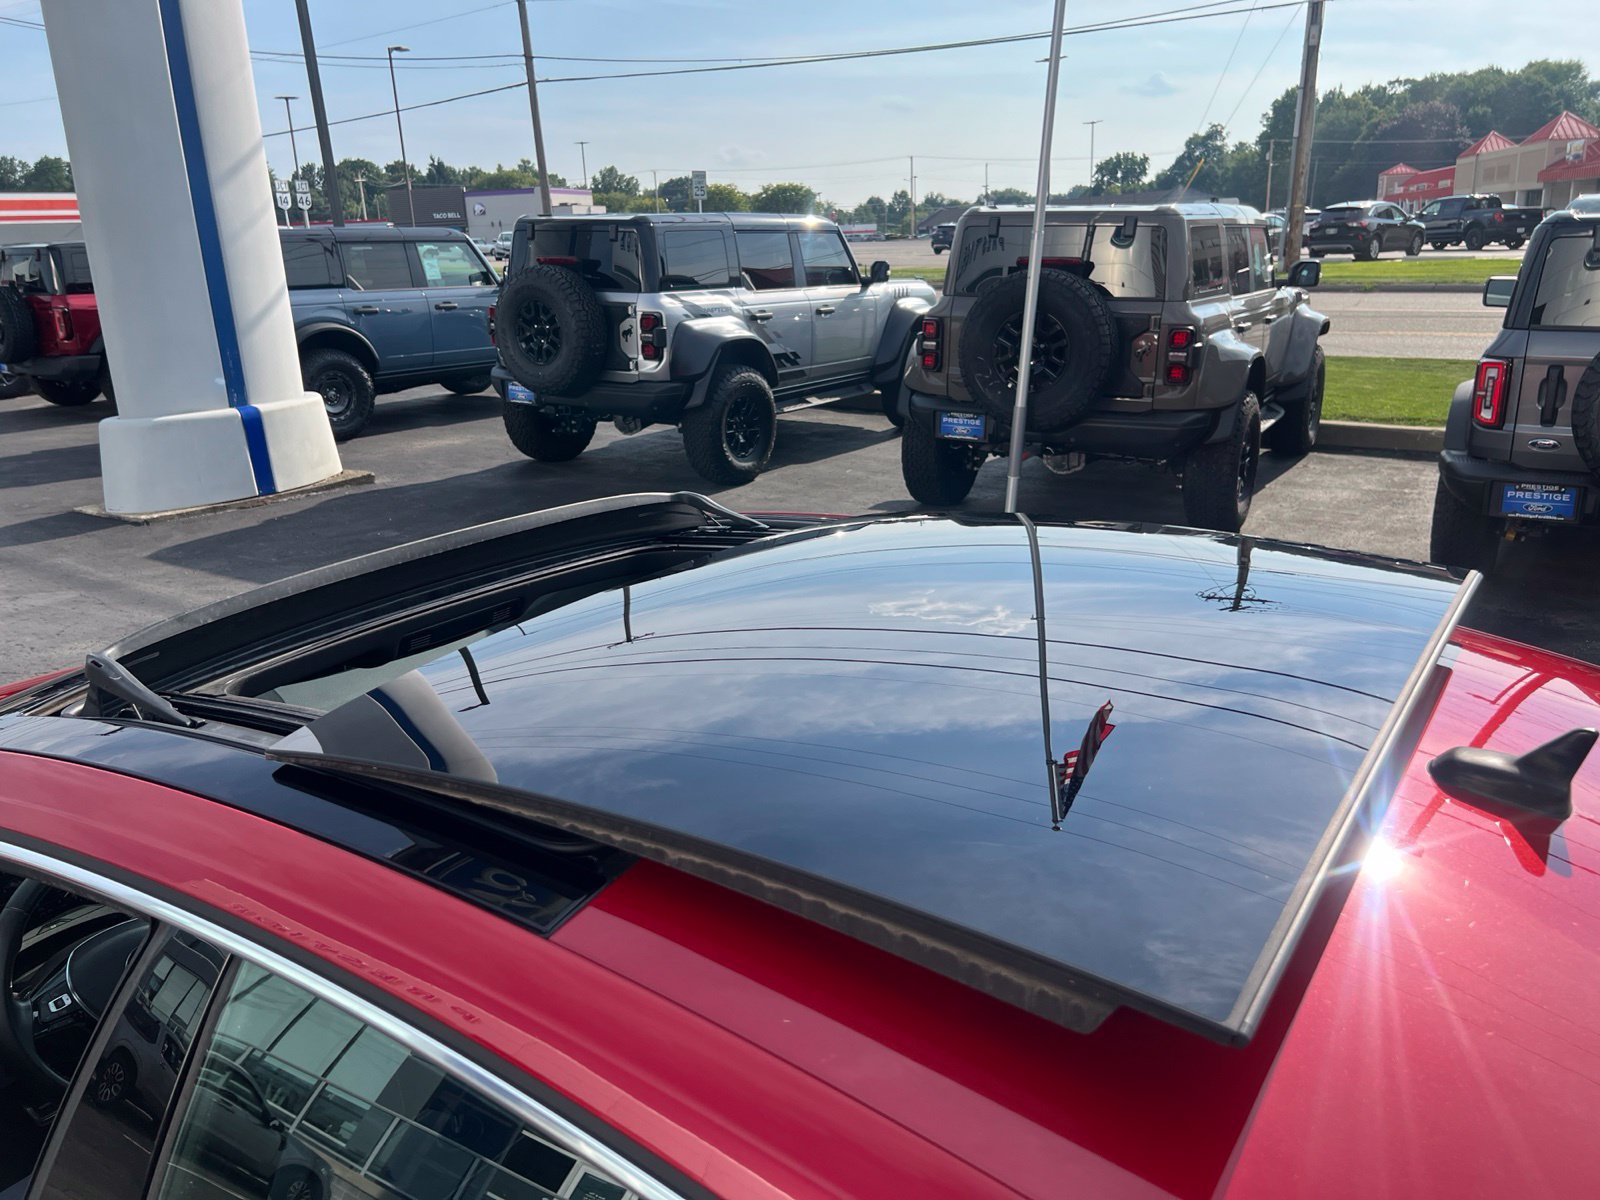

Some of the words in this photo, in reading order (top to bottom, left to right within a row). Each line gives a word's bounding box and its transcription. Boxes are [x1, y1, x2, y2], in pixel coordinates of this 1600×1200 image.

[277, 182, 288, 190] JCT
[297, 182, 308, 190] JCT
[694, 186, 705, 197] 25
[279, 196, 289, 206] 14
[298, 196, 311, 206] 46
[943, 417, 981, 425] PRESTIGE
[1507, 491, 1571, 501] PRESTIGE
[1527, 504, 1547, 512] Ford
